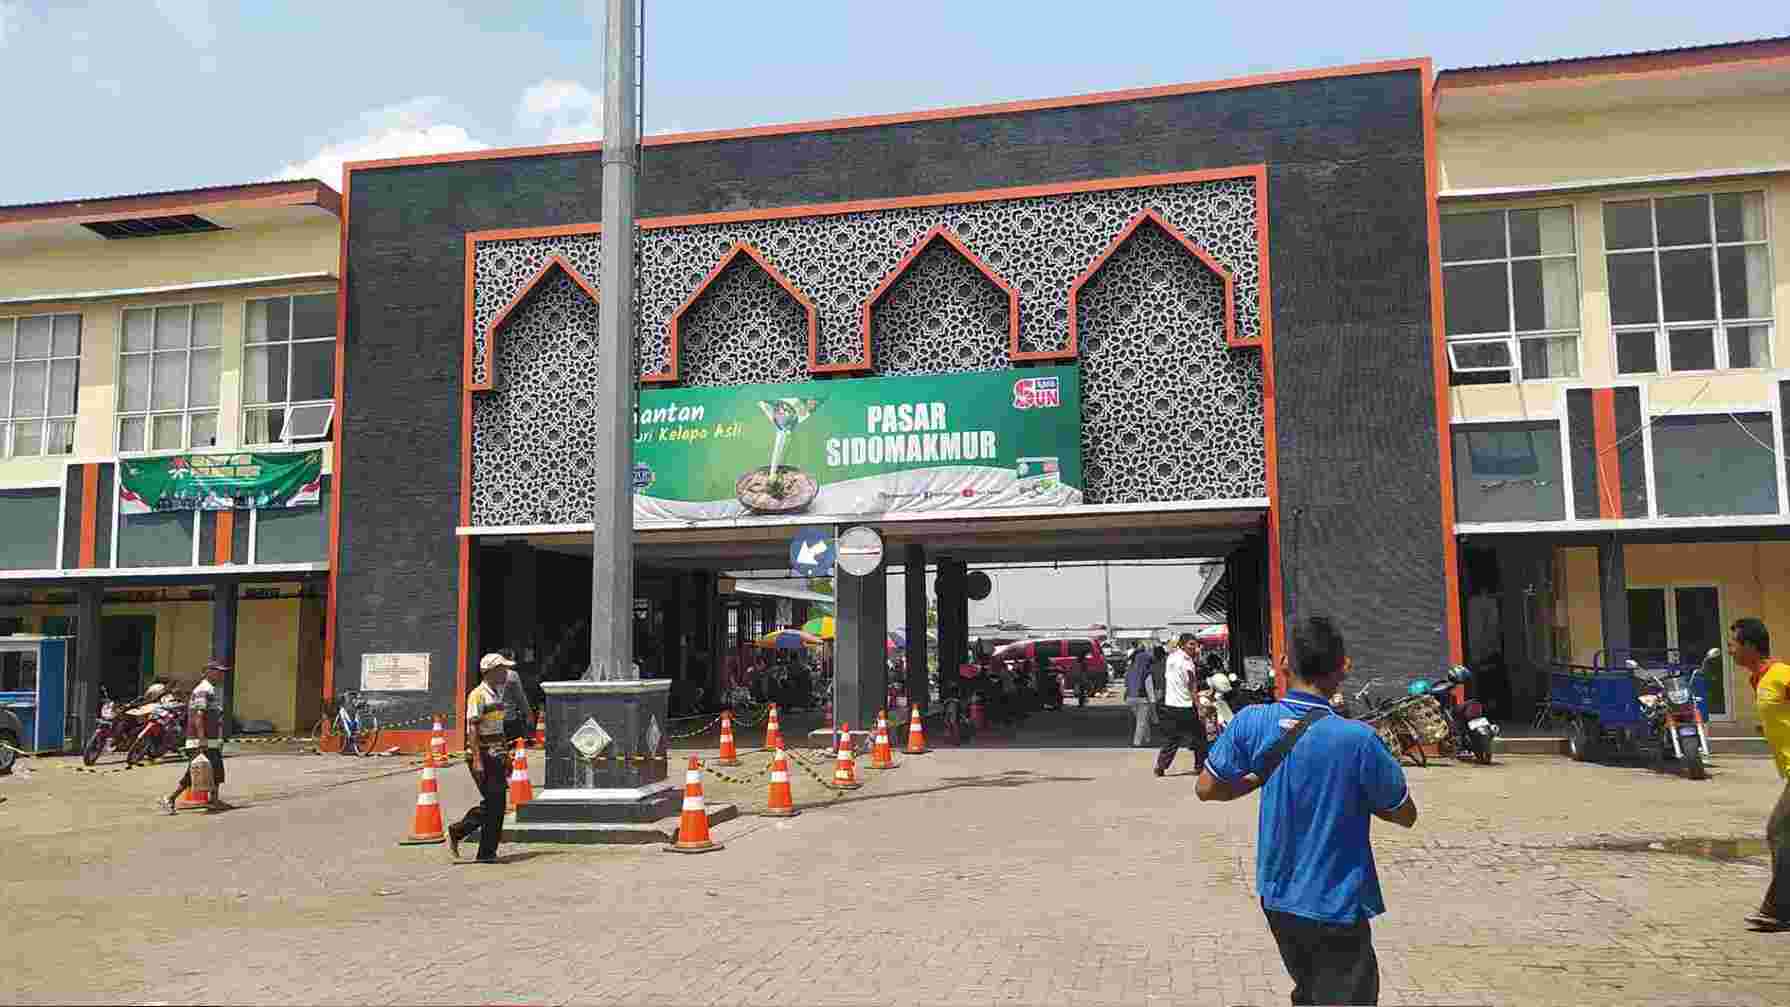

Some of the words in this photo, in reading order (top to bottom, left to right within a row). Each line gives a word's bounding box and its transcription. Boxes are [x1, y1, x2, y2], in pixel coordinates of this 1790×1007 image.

[633, 402, 705, 424] antan
[867, 402, 947, 433] PASAR
[826, 430, 997, 467] SIDOMAKMUR
